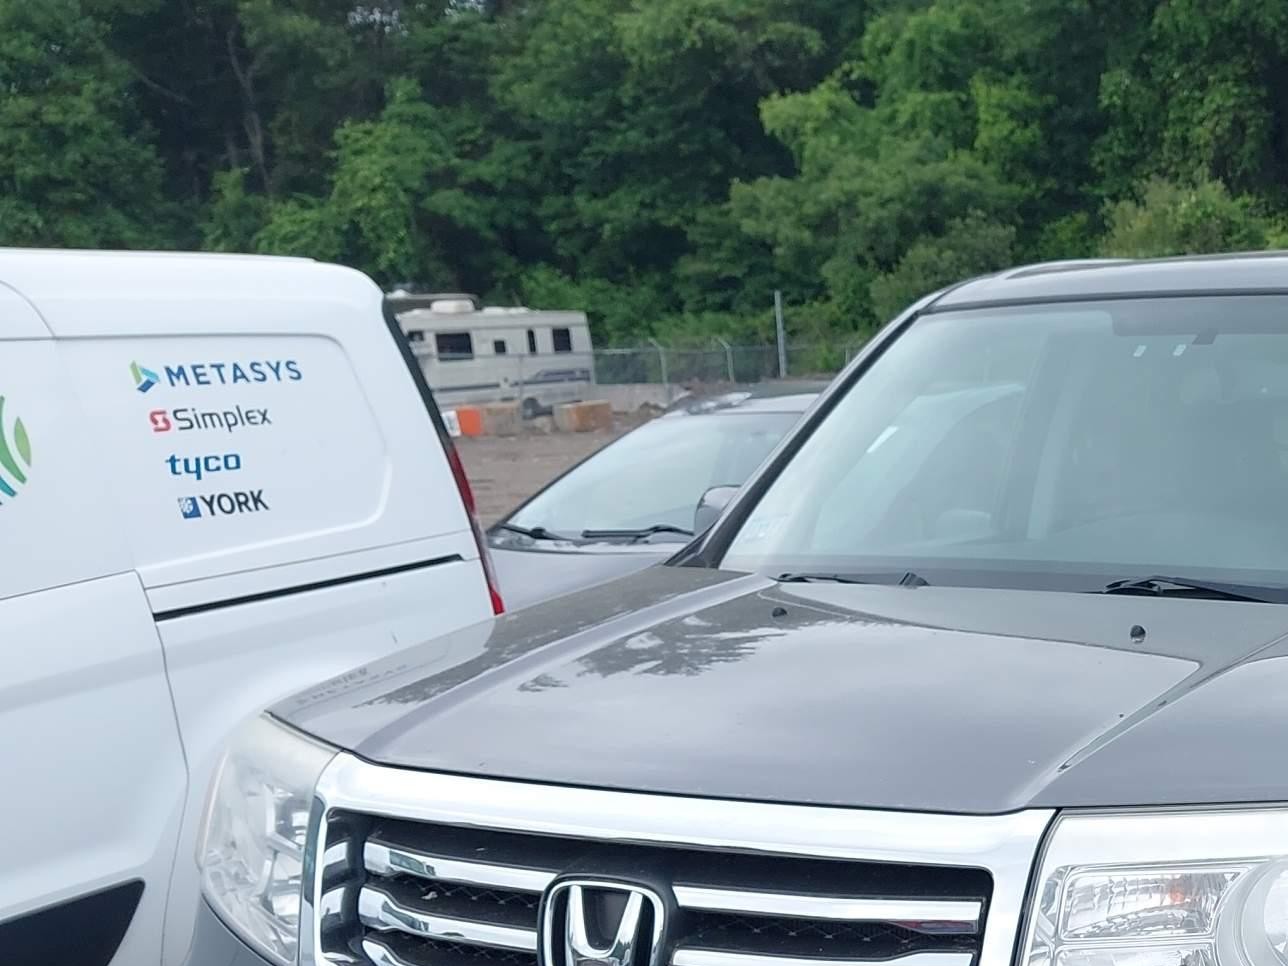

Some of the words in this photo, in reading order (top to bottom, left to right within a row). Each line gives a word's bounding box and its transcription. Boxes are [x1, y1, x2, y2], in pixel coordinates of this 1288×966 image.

[164, 360, 302, 387] METASYS
[173, 405, 272, 433] Simplex
[165, 452, 241, 481] tyco
[200, 489, 270, 518] YORK
